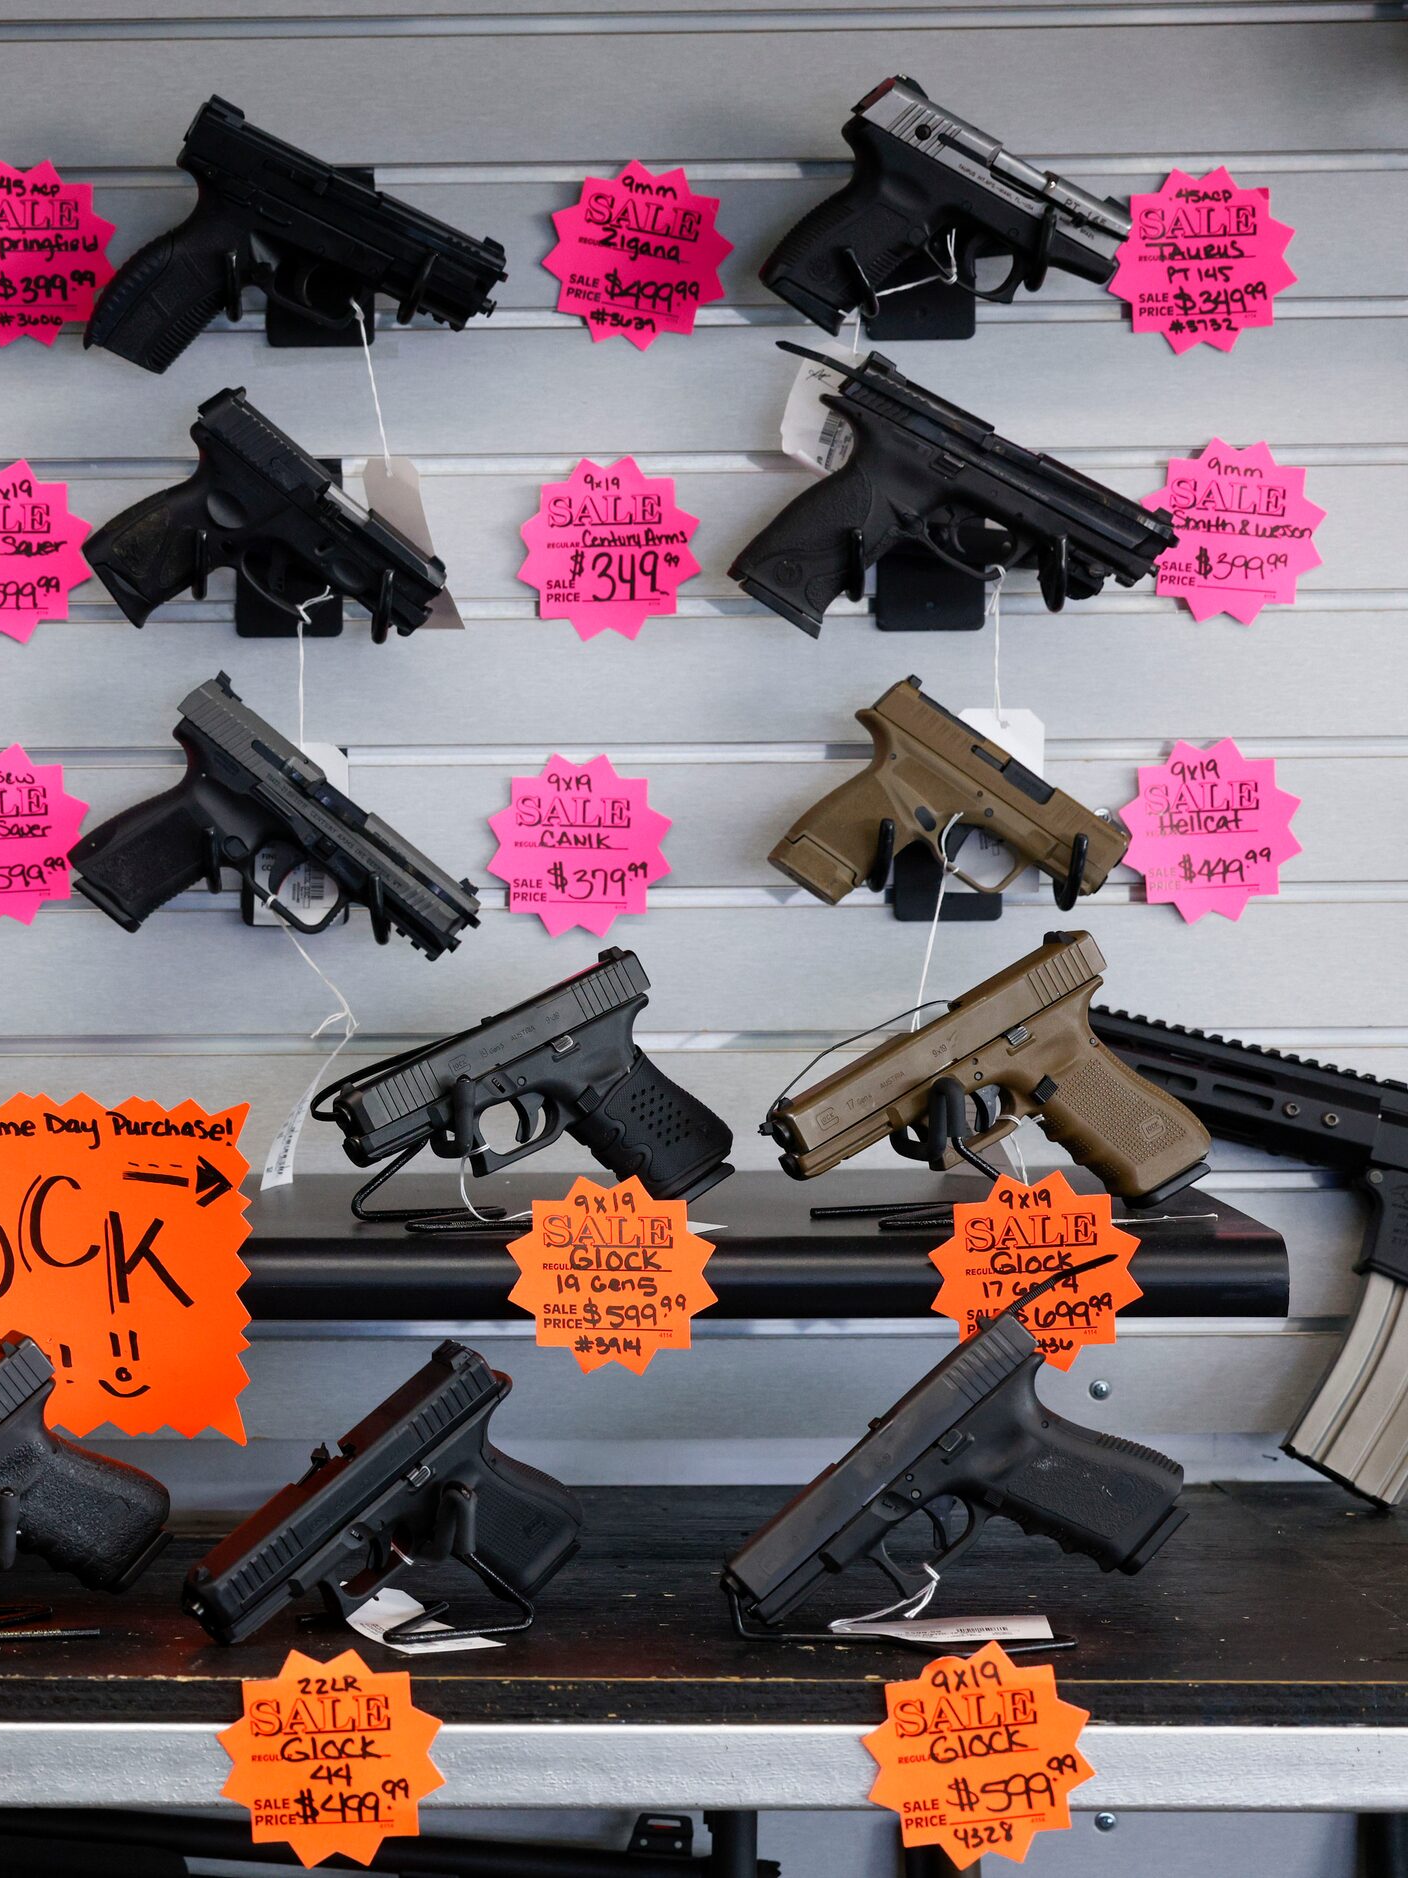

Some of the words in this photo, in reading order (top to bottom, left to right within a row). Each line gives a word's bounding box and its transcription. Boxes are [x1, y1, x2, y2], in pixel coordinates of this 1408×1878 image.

[585, 193, 701, 242] SALE
[1139, 205, 1257, 240] SALE
[1146, 240, 1245, 261] TAURUS
[1139, 306, 1173, 316] PRICE
[1208, 457, 1263, 478] 9mm
[1170, 478, 1286, 517] SALE
[548, 494, 661, 527] SALE
[582, 529, 641, 548] Century
[644, 528, 687, 545] Arms
[1239, 520, 1250, 535] &
[547, 593, 580, 602] PRICE
[1145, 781, 1259, 815] SALE
[516, 796, 630, 828] SALE
[1159, 809, 1242, 833] Hellcat
[541, 830, 611, 849] CANIK
[513, 879, 542, 888] SALE
[513, 893, 547, 902] PRICE
[44, 1112, 101, 1150] Day
[105, 1111, 234, 1147] Purchase!
[543, 1215, 673, 1249] SALE
[965, 1212, 1097, 1253] SALE
[570, 1245, 662, 1271] Glock
[990, 1251, 1072, 1275] Glock
[544, 1303, 577, 1315] SALE
[544, 1318, 582, 1329] PRICE
[297, 1675, 362, 1694] 22LR
[250, 1694, 390, 1737] SALE
[893, 1689, 1037, 1738] SALE
[281, 1737, 381, 1762] Glock
[930, 1726, 1028, 1764] Glock
[310, 1764, 352, 1787] 44
[254, 1799, 289, 1810] SALE
[255, 1814, 296, 1826] PRICE
[954, 1822, 1013, 1848] 4328
